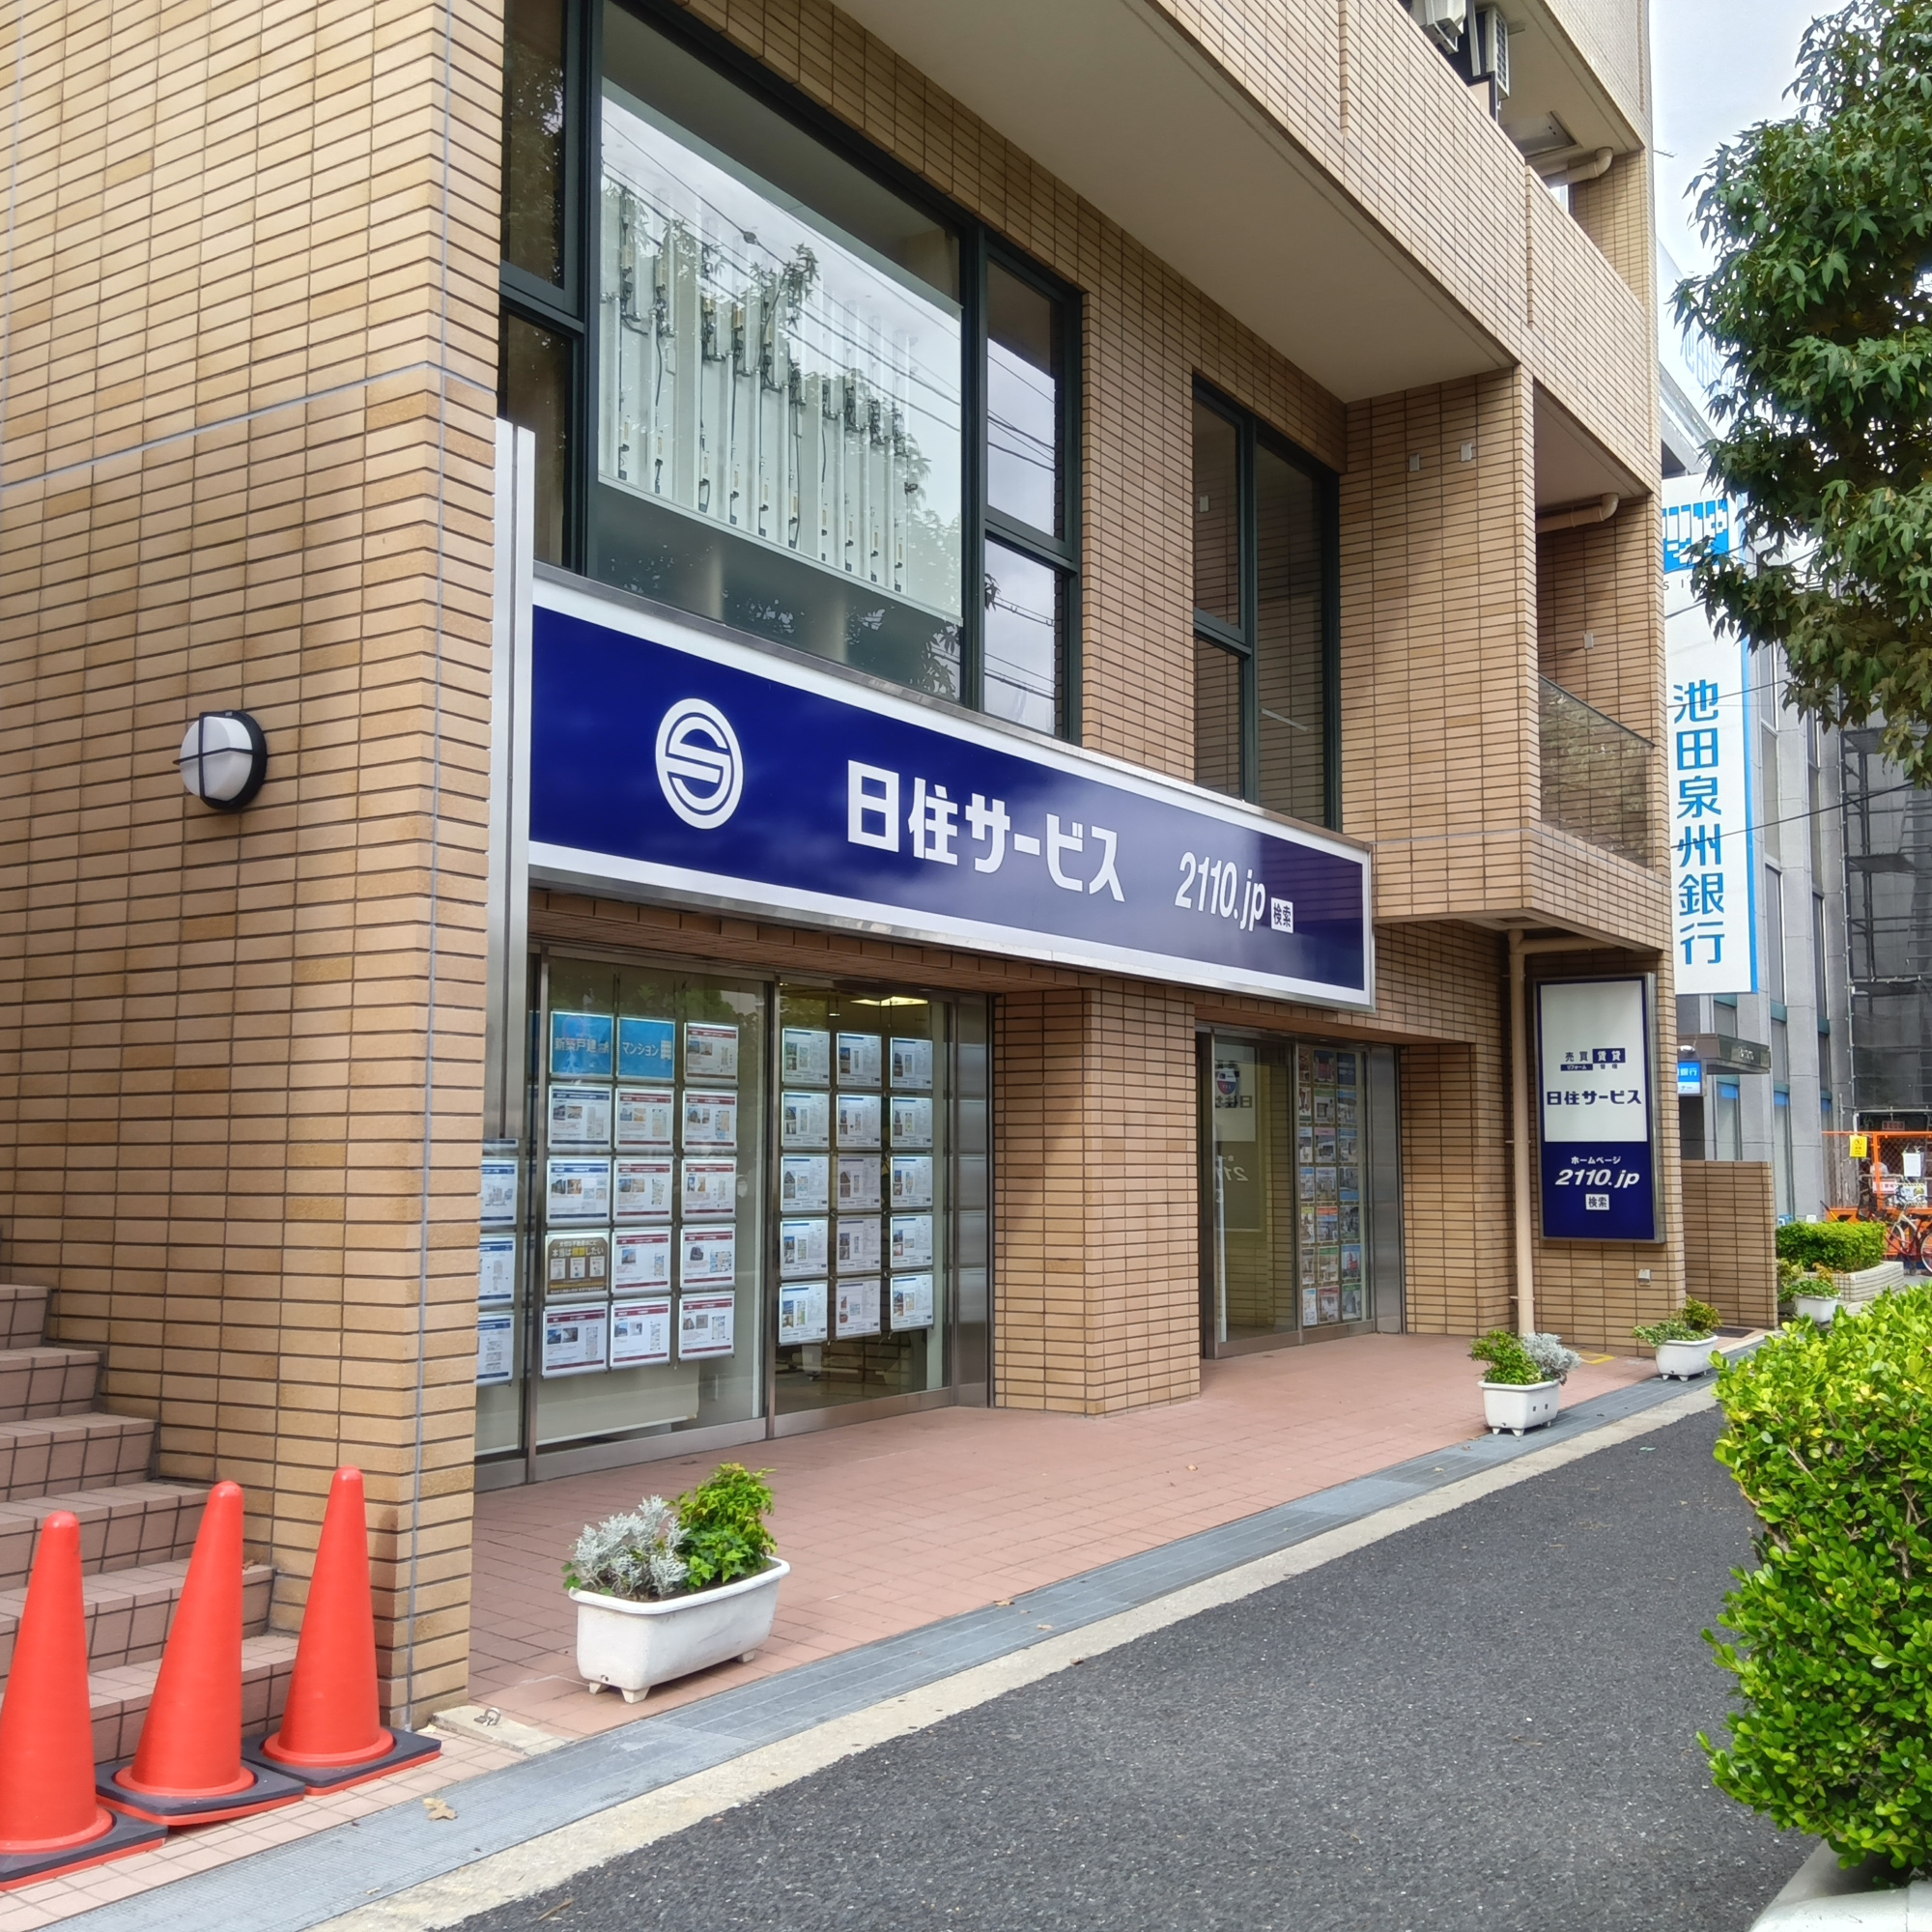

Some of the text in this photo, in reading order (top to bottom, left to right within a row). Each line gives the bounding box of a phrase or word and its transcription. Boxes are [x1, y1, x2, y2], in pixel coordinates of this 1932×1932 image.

[1673, 678, 1725, 965] 池田泉州銀行
[847, 759, 1292, 932] 日住サービス 2110.jp 検索
[622, 1041, 660, 1057] マンション
[1565, 1050, 1621, 1063] 売買 賃貸
[1546, 1089, 1642, 1106] 日住サービス
[1571, 1155, 1621, 1165] ホームページ
[1554, 1169, 1640, 1189] 2110.jp
[1588, 1196, 1607, 1208] 検索
